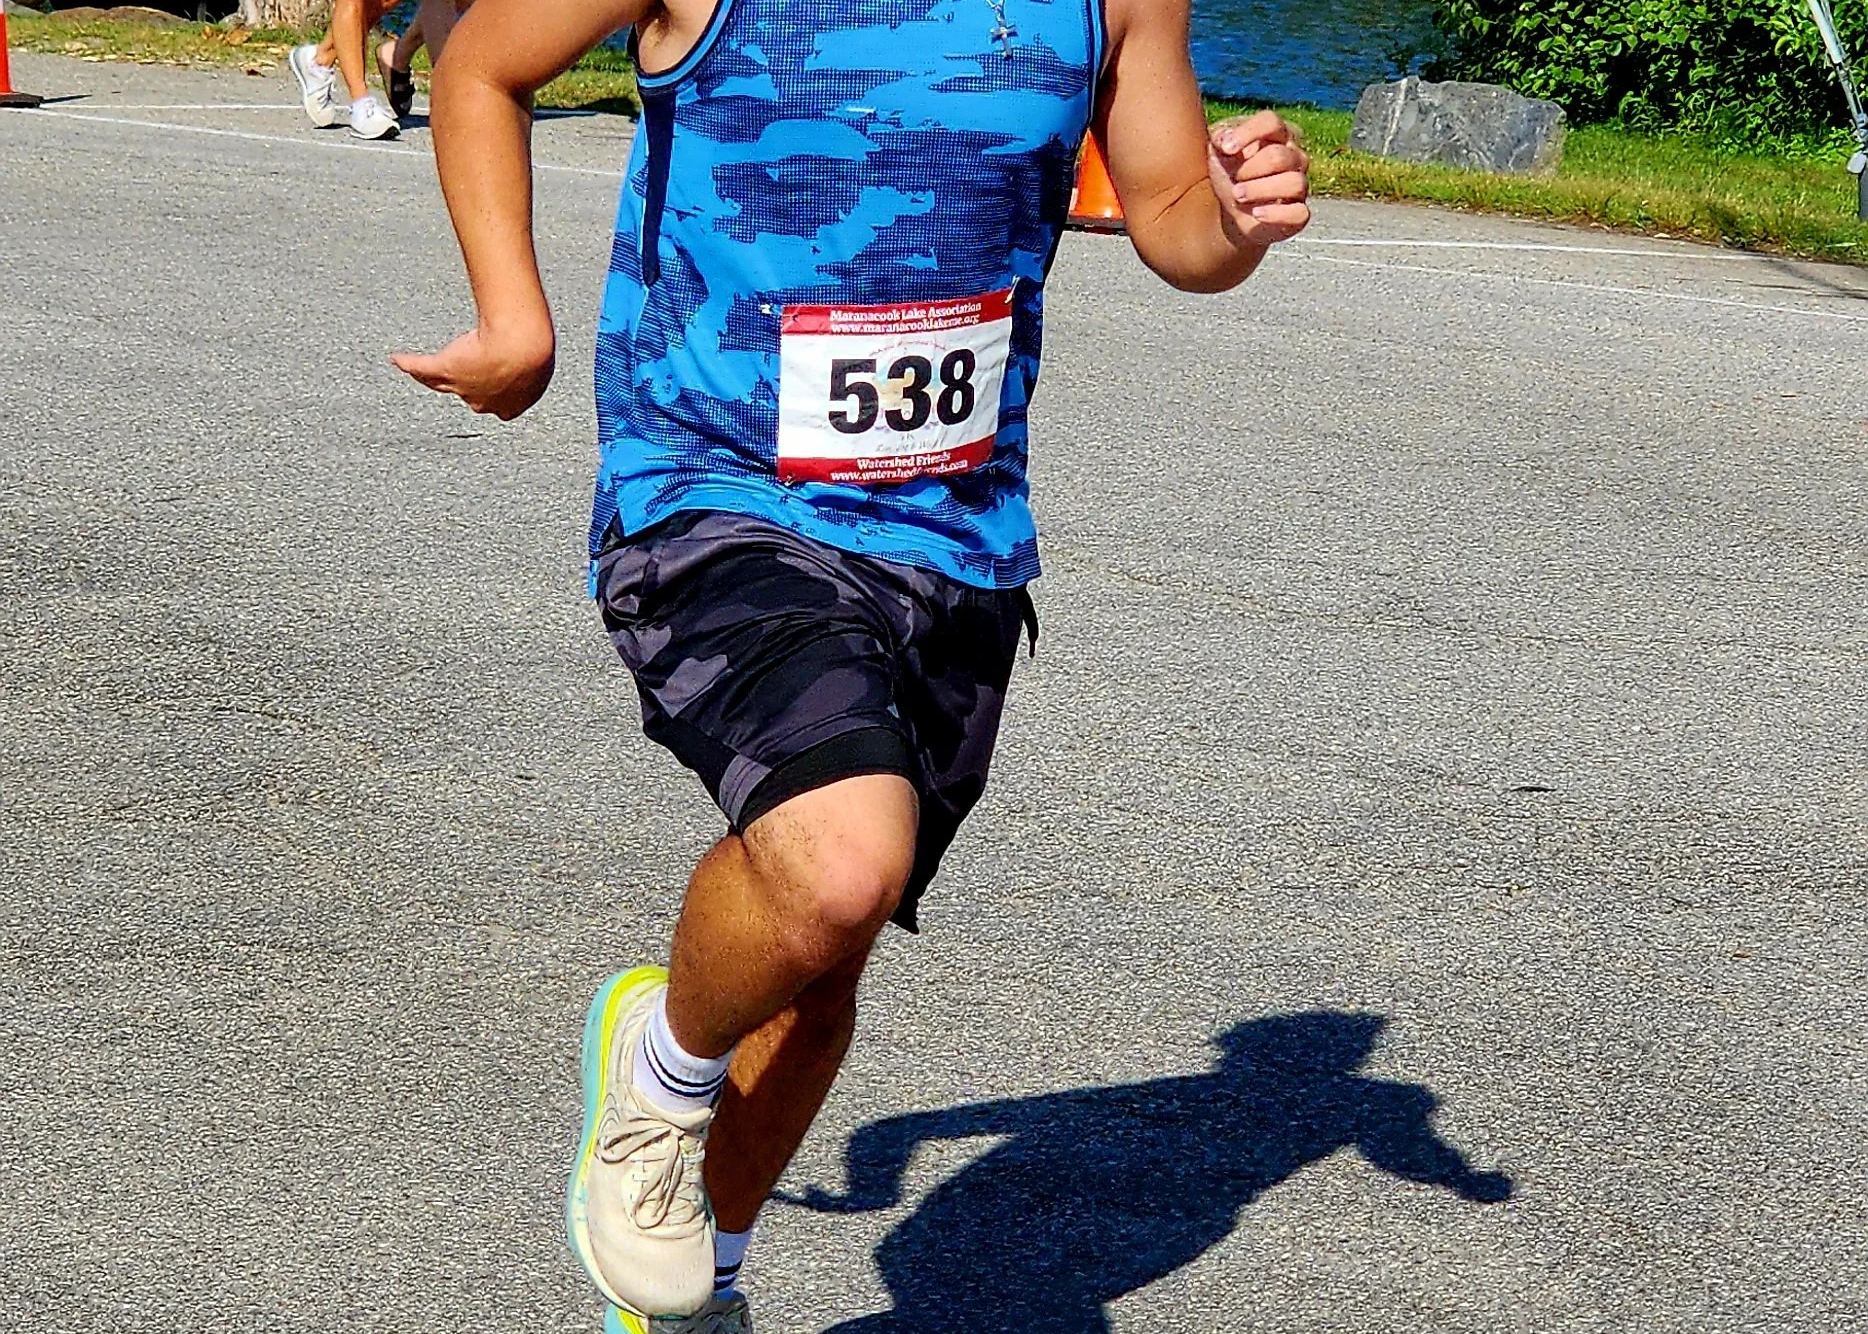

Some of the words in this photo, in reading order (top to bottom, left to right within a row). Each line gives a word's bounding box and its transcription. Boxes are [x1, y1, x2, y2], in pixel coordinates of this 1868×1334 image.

[830, 309, 900, 322] Maranacook
[901, 307, 926, 320] Lake
[928, 302, 982, 318] Association
[828, 348, 976, 435] 538
[857, 455, 915, 470] Watershed
